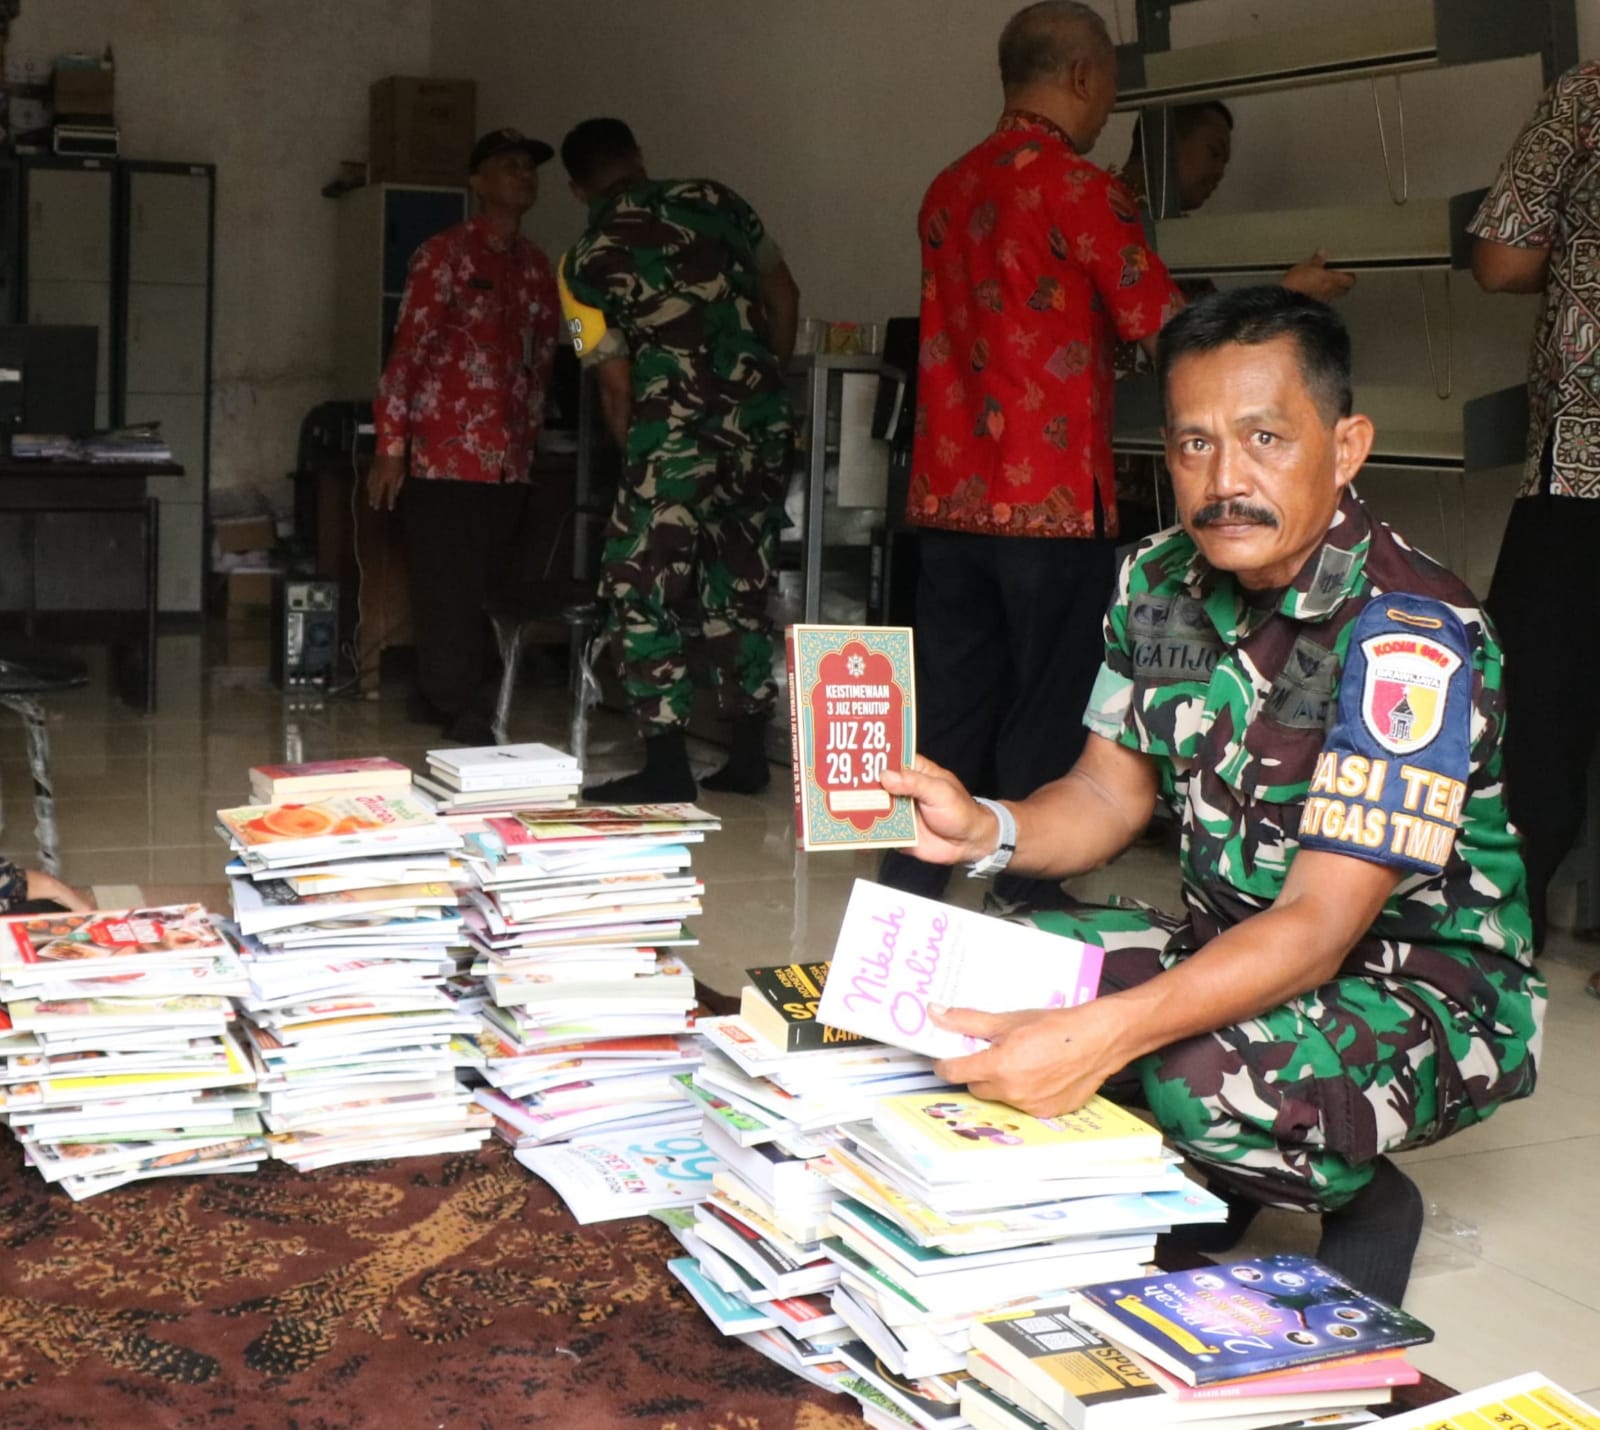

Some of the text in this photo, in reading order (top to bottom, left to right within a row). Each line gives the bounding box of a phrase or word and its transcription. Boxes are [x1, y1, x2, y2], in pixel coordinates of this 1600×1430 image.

[1373, 641, 1417, 657] KODIM
[825, 684, 890, 699] KEISTIMEWAAN
[826, 701, 891, 716] 3 JUZ PENUTUP
[826, 721, 891, 753] JUZ 28,
[826, 752, 888, 788] 29, 30
[1308, 752, 1467, 824] ASI TER
[1391, 812, 1456, 867] TMM
[843, 906, 907, 1012] Nikah
[889, 911, 949, 1036] Online
